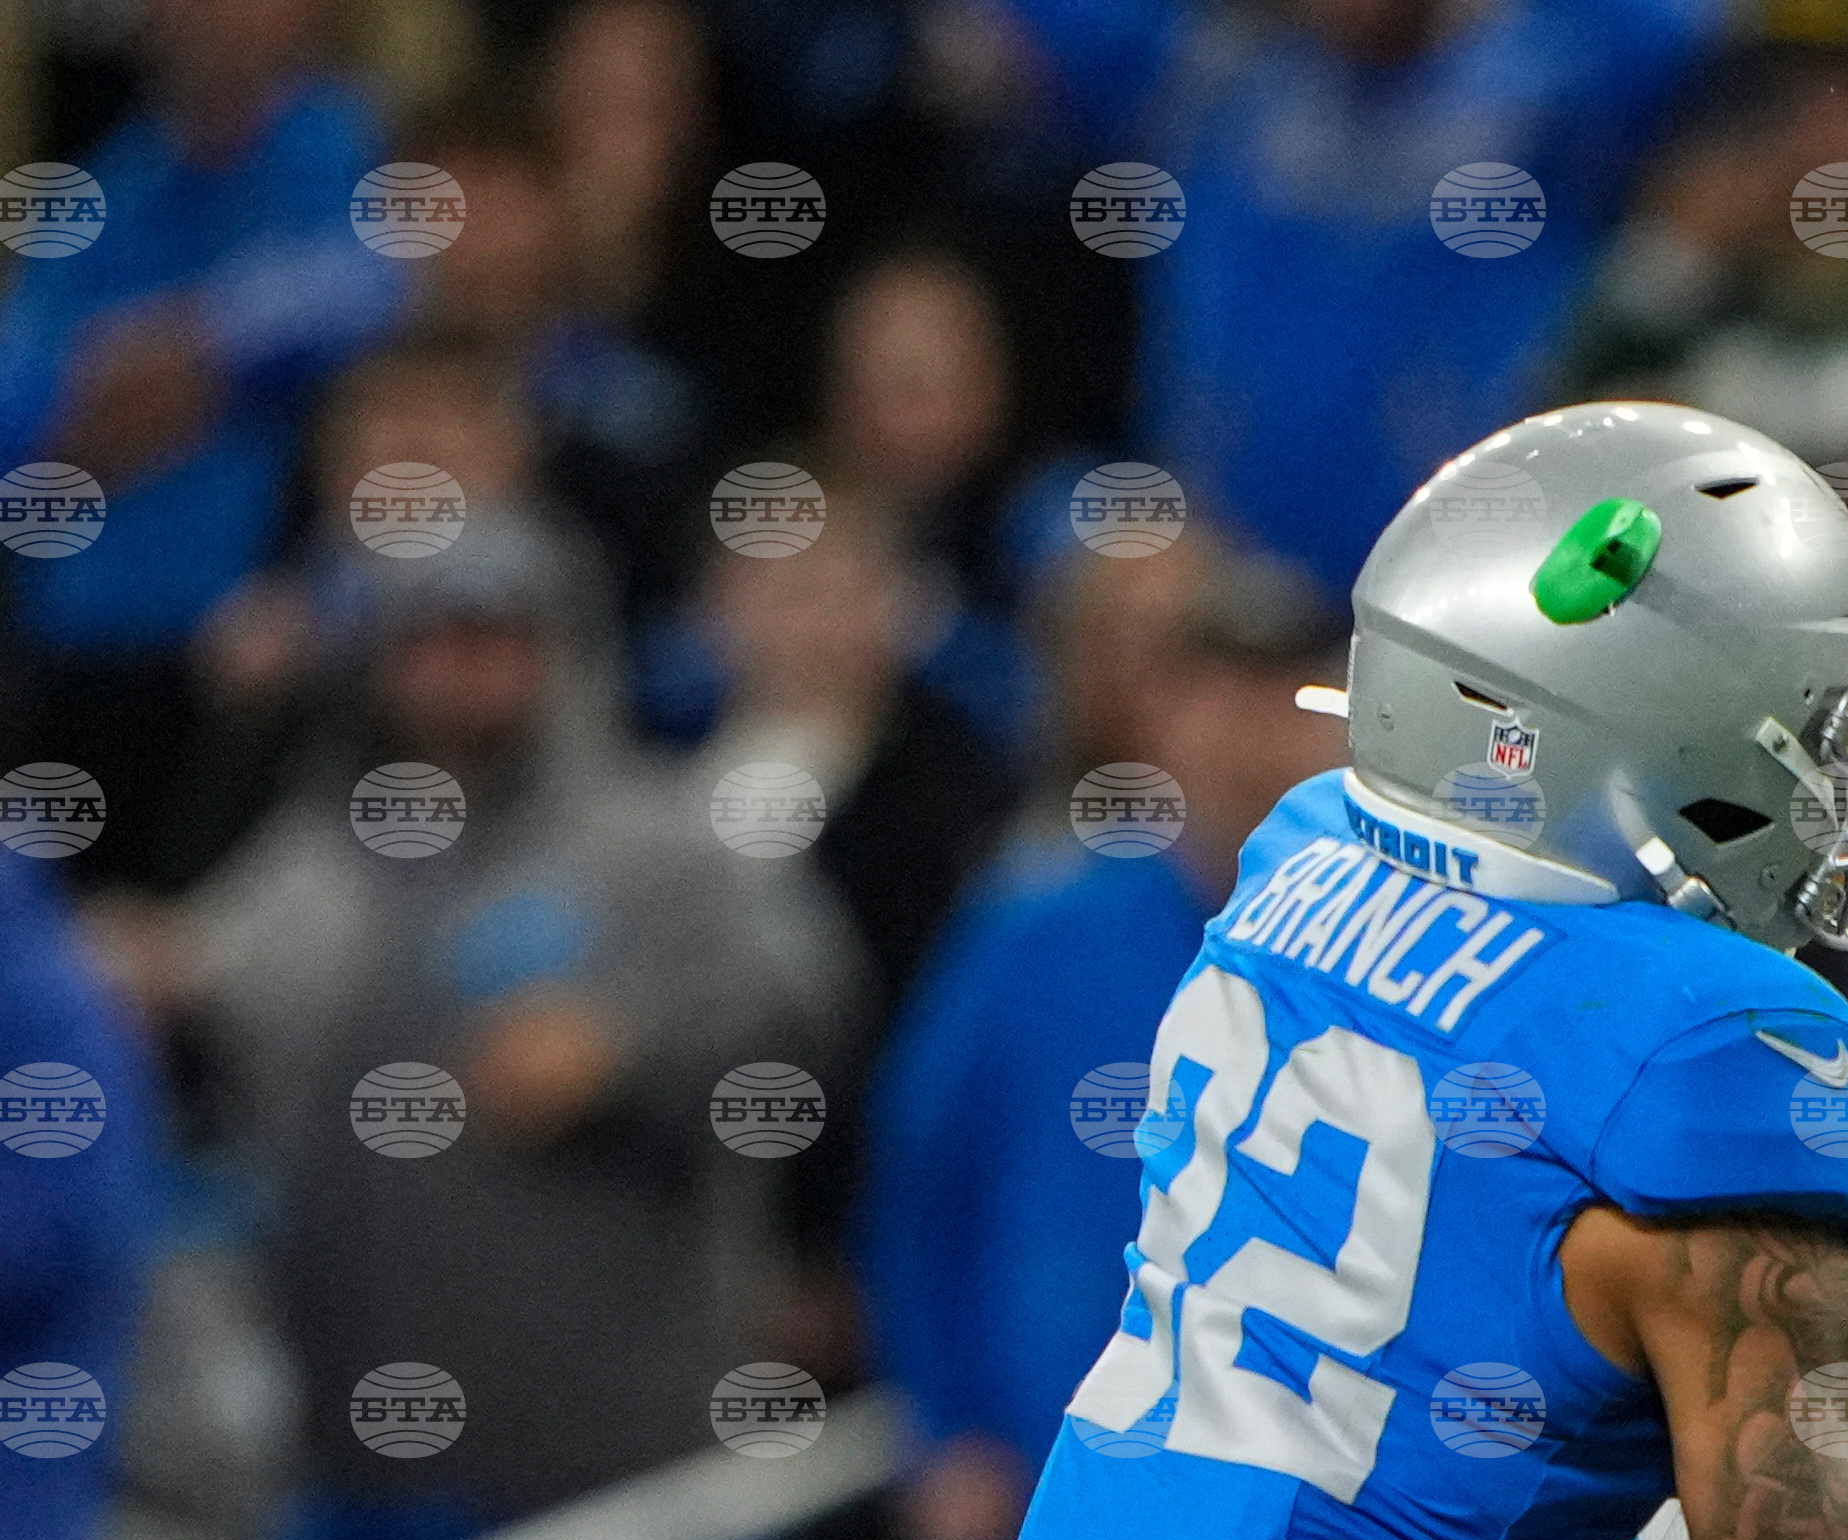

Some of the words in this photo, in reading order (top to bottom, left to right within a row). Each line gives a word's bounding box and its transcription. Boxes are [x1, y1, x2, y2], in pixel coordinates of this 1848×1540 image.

[1495, 743, 1530, 770] NFL
[1343, 795, 1480, 888] TROIT
[1226, 837, 1545, 1033] BRANCH
